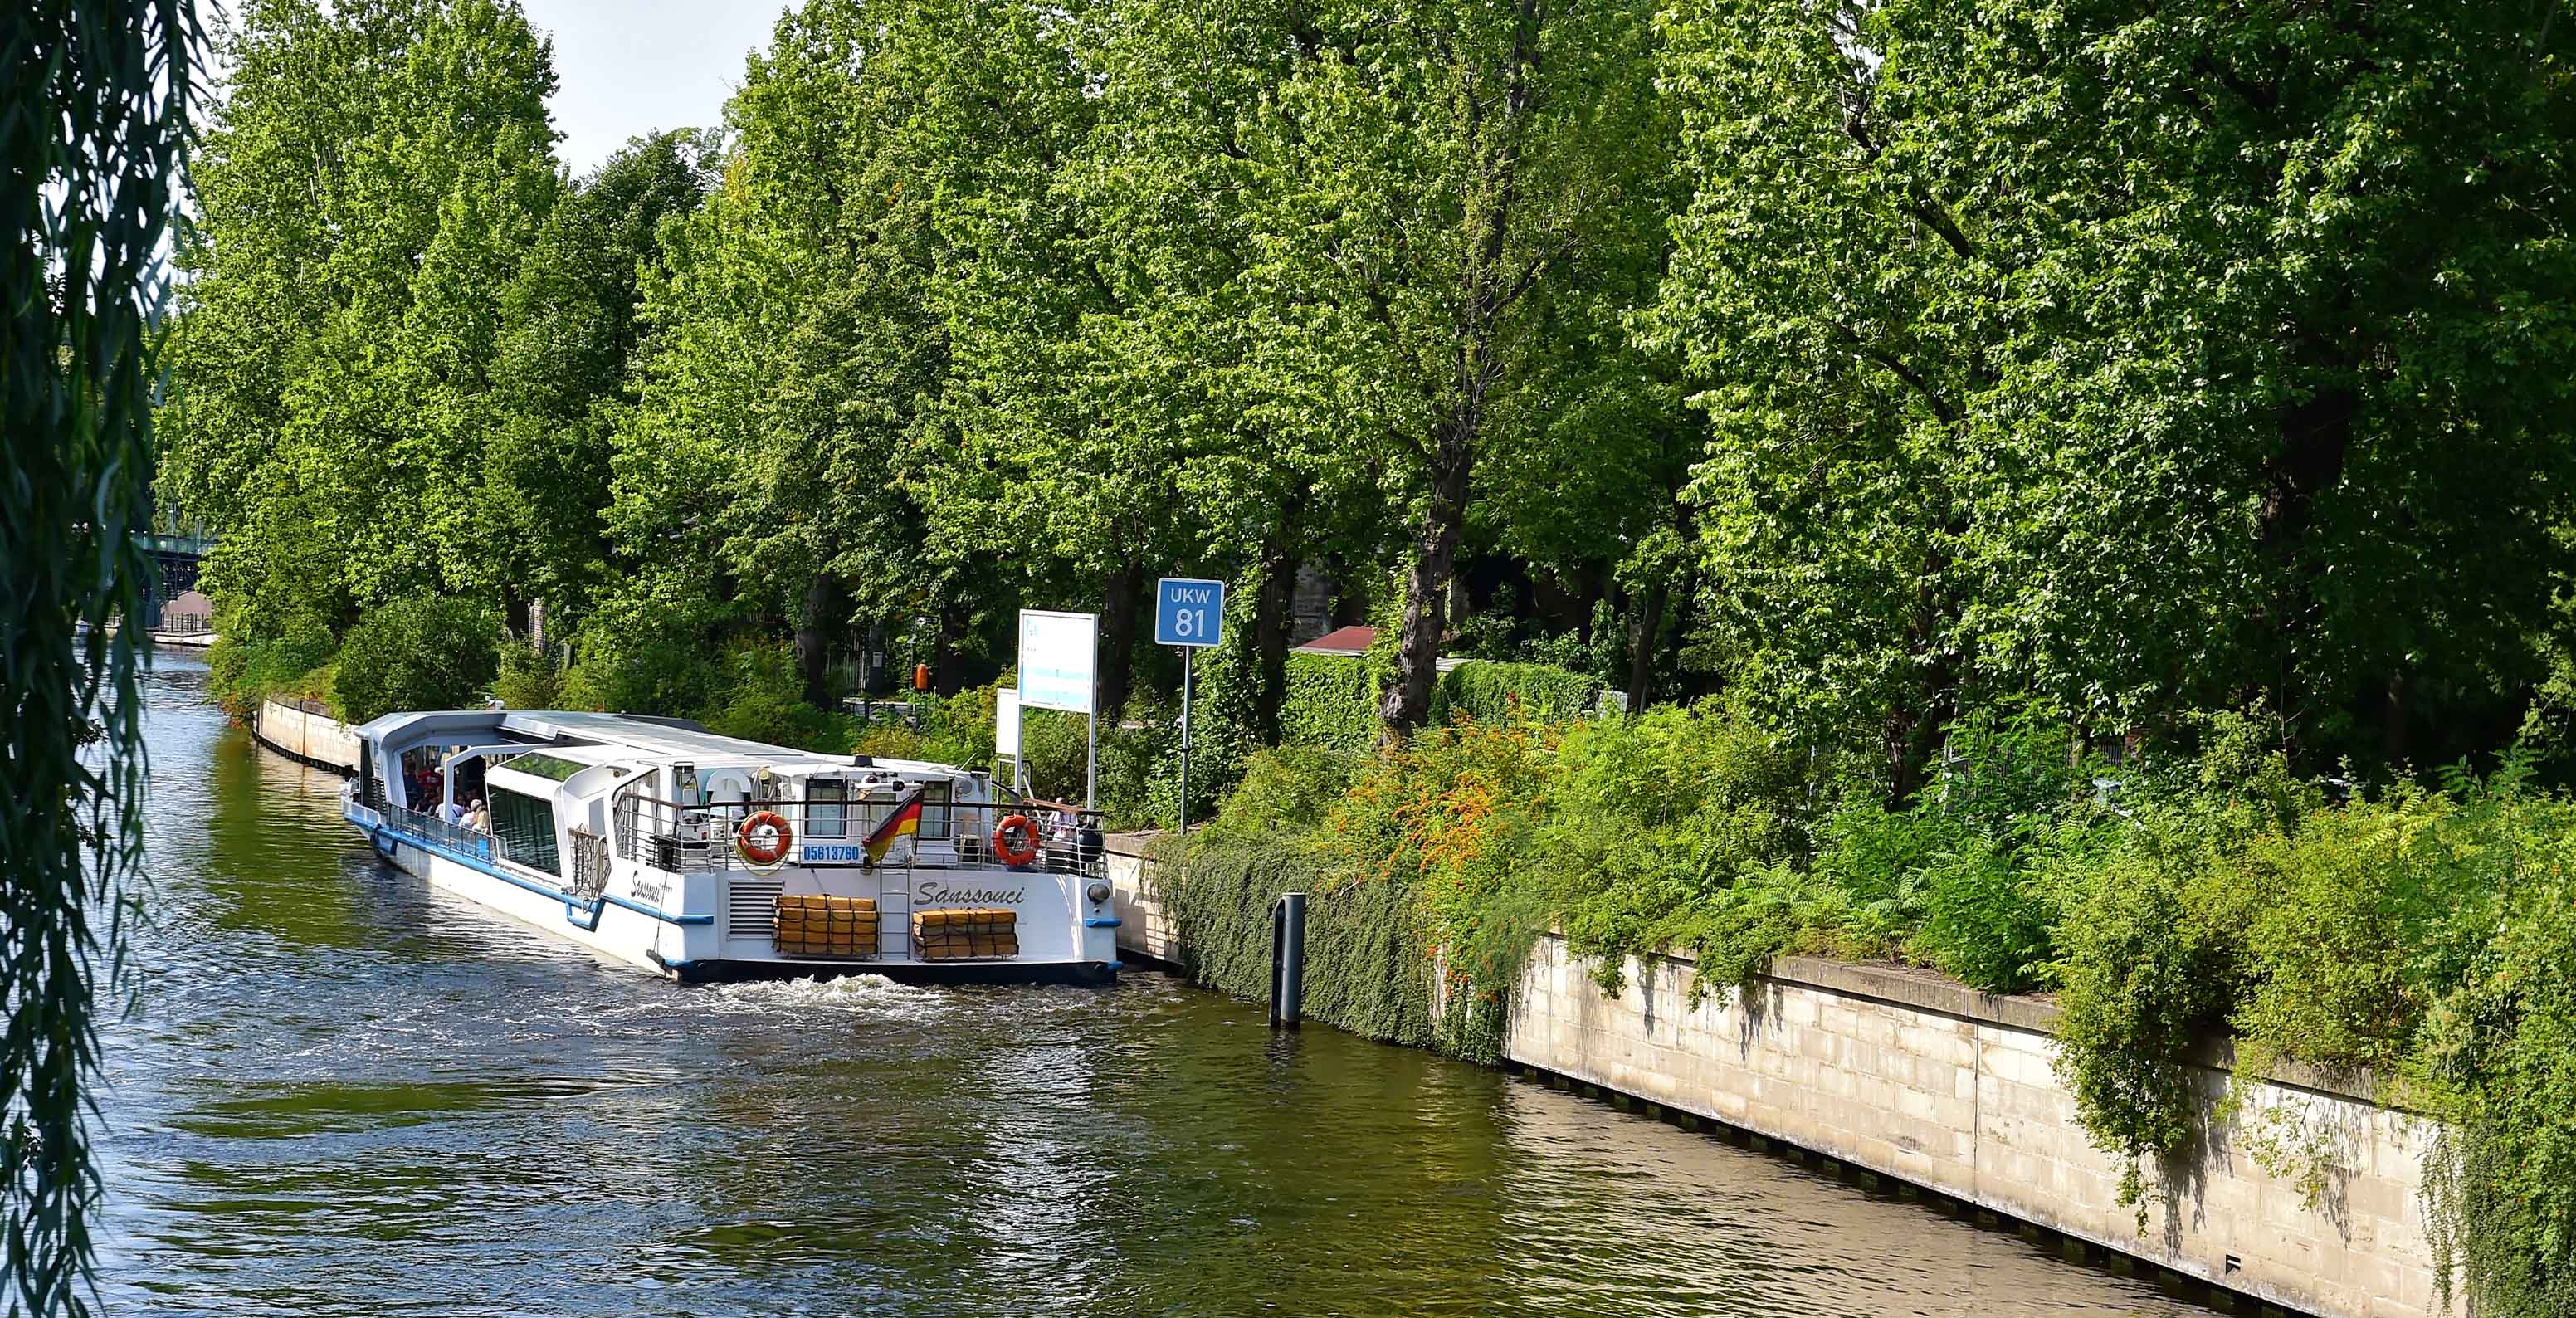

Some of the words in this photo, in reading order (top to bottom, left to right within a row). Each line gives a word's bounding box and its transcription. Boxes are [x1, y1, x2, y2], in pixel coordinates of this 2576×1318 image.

[1171, 588, 1211, 604] UKW
[1175, 608, 1204, 637] 81
[803, 846, 860, 861] 05613760
[913, 881, 1025, 905] Sanssouci
